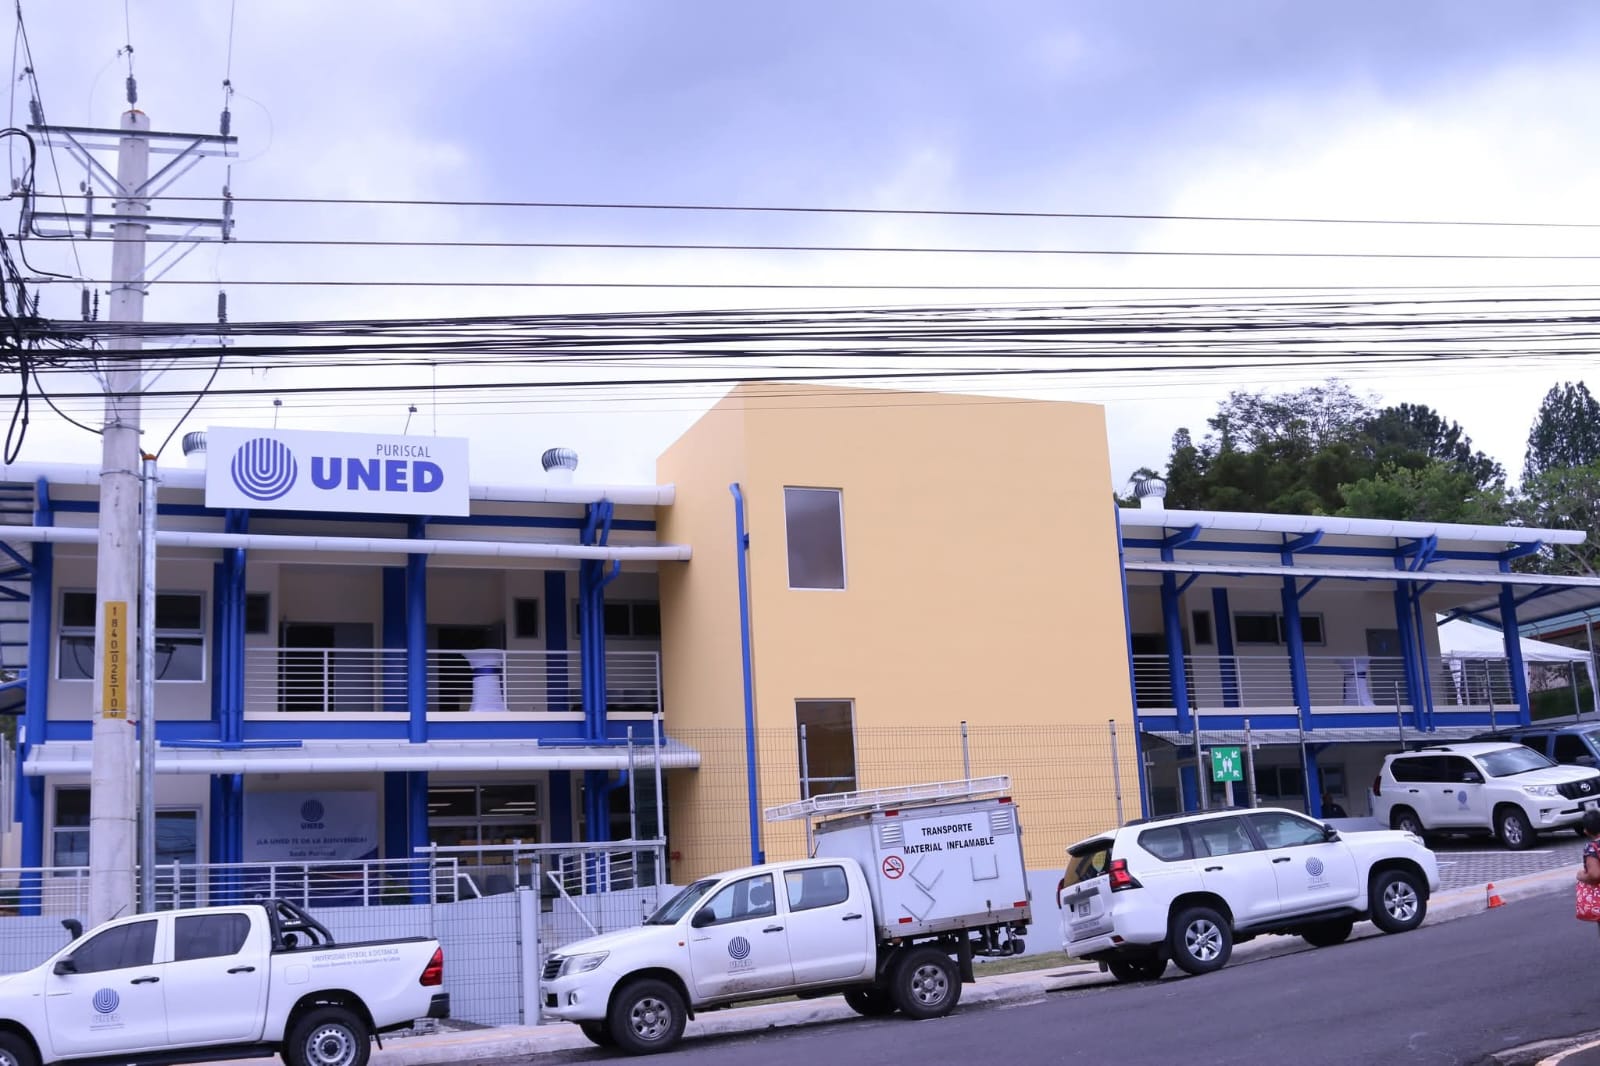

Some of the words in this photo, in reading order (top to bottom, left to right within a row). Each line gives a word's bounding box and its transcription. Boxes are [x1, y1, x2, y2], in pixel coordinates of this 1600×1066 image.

[376, 444, 431, 458] PURISCAL
[310, 456, 444, 493] UNED
[921, 823, 973, 836] TRANSPORTE
[903, 843, 943, 855] MATERIAL
[946, 836, 995, 850] INFLAMABLE
